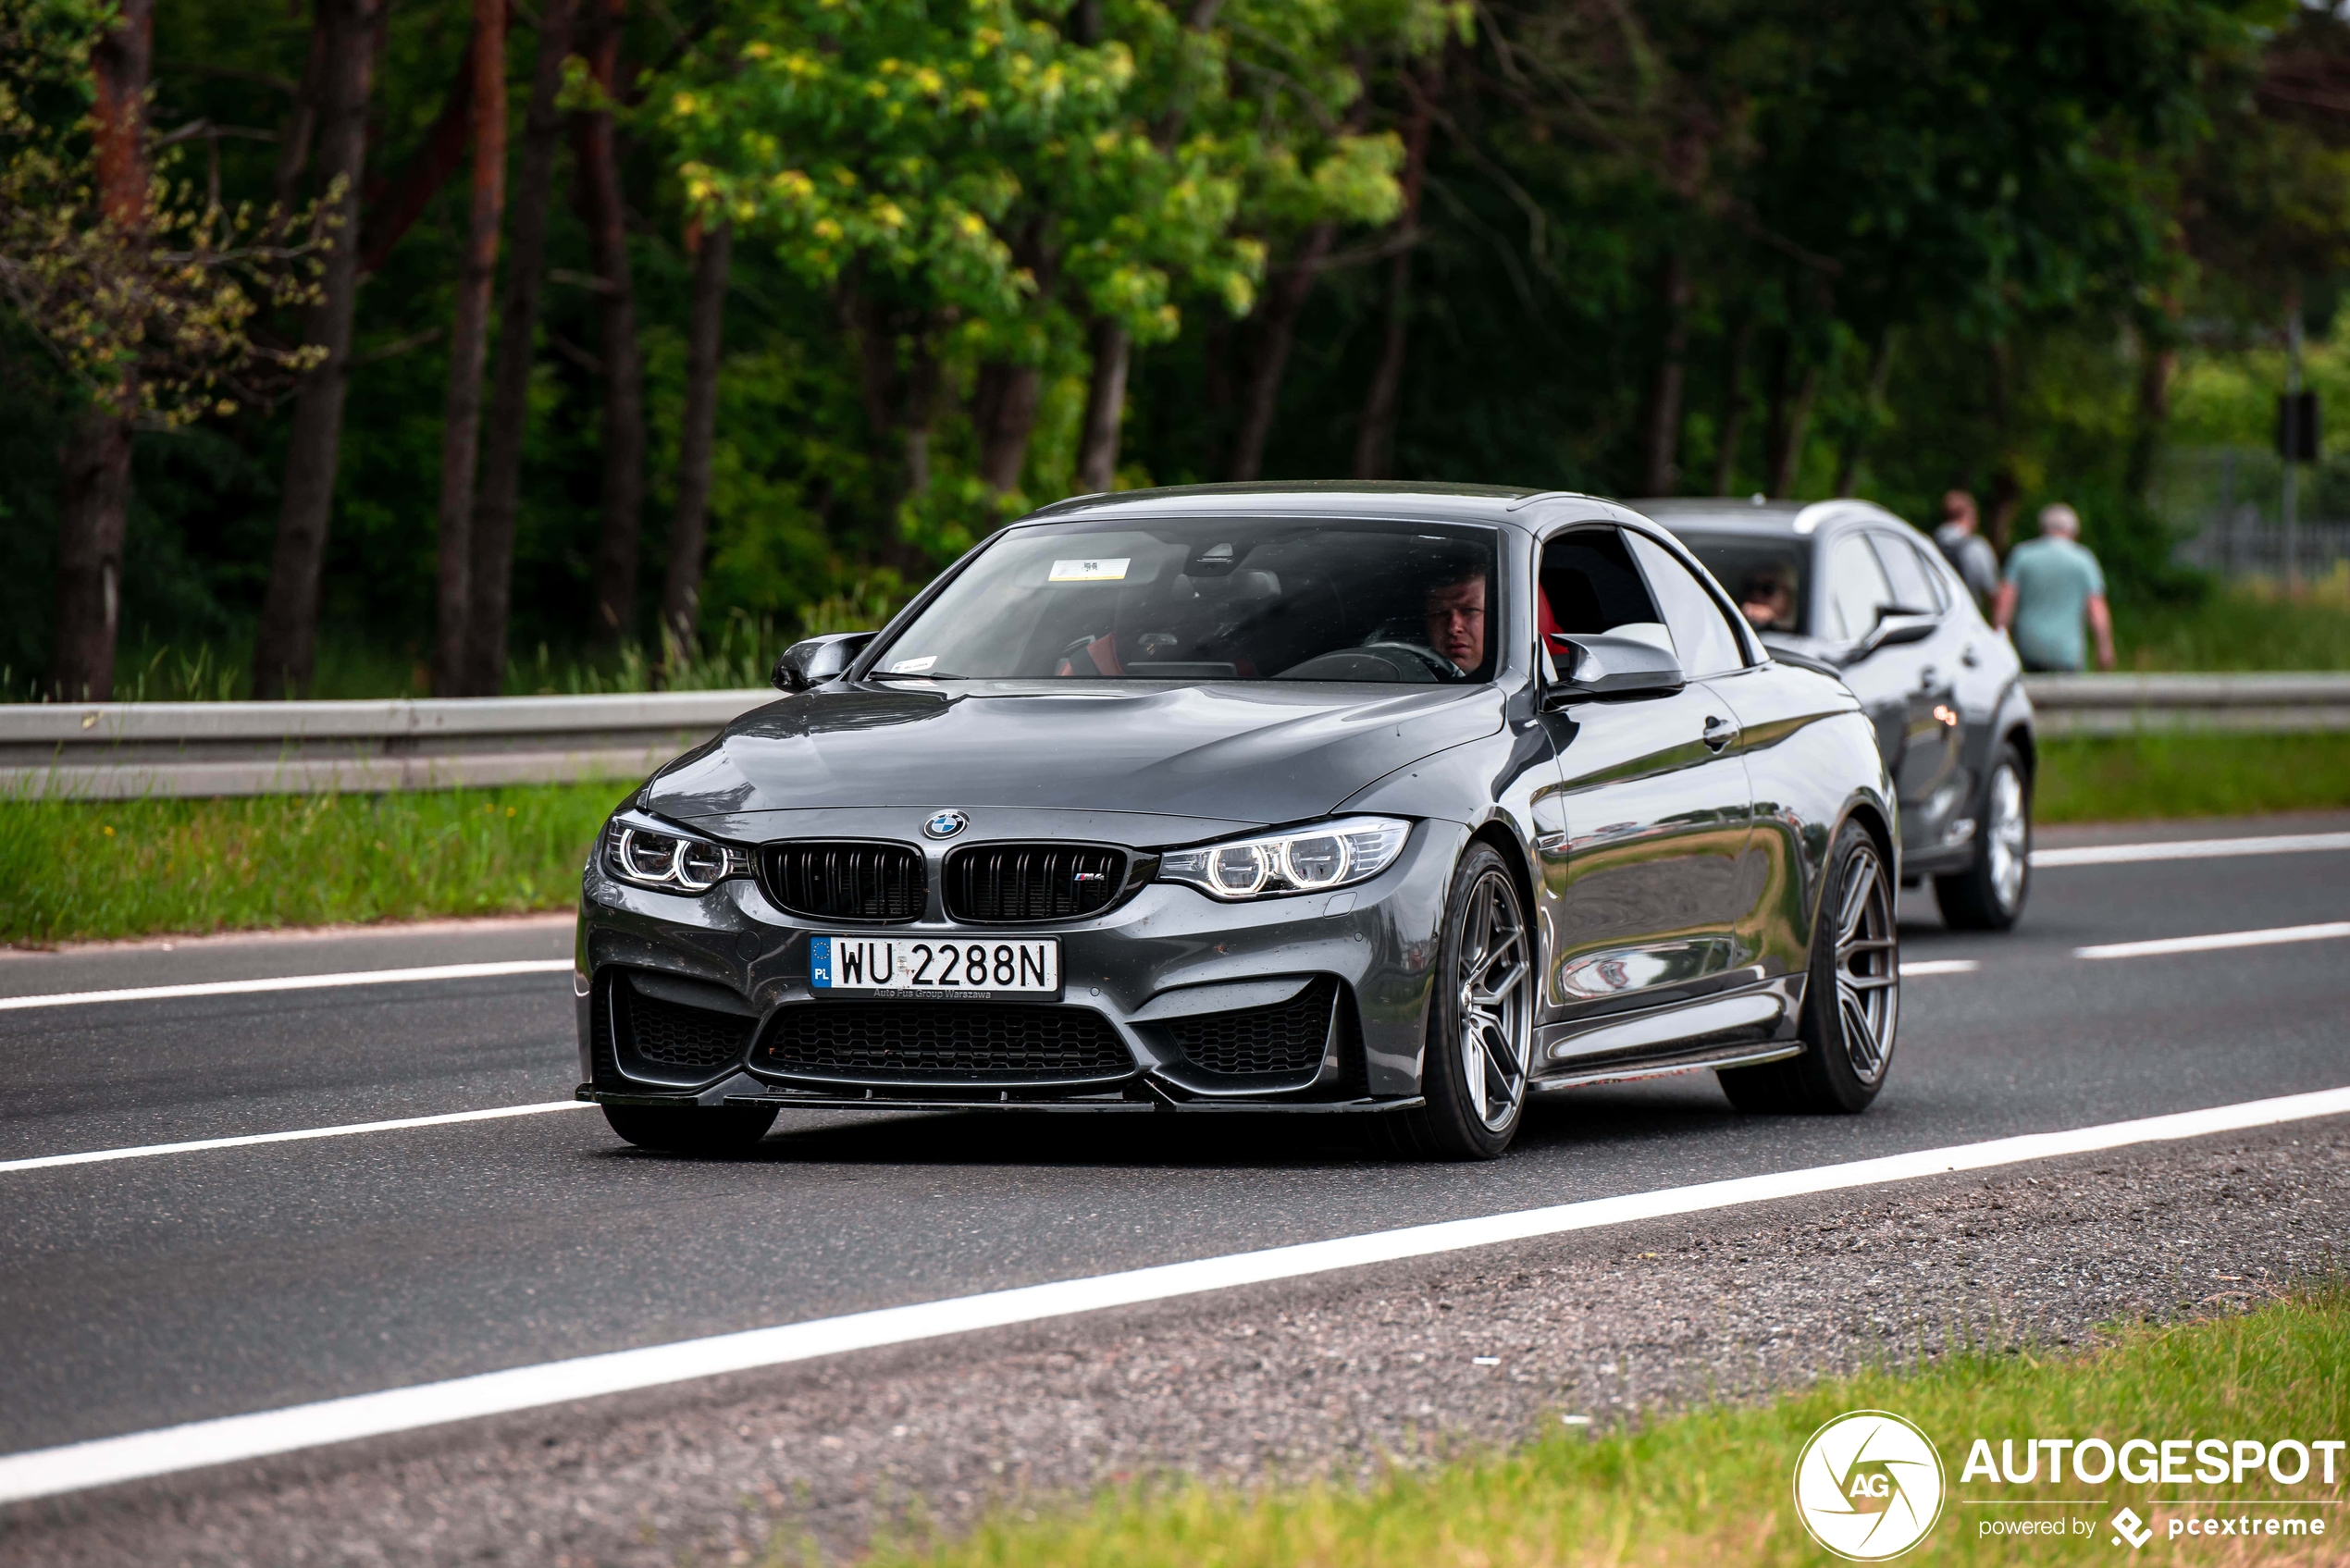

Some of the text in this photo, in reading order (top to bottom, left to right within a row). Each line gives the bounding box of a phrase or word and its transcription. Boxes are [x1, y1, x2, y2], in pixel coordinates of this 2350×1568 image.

[1082, 872, 1105, 881] M4
[840, 942, 1045, 986] WU 2288N
[814, 969, 829, 980] PL
[873, 988, 991, 999] Auto Fus Group Warszawa
